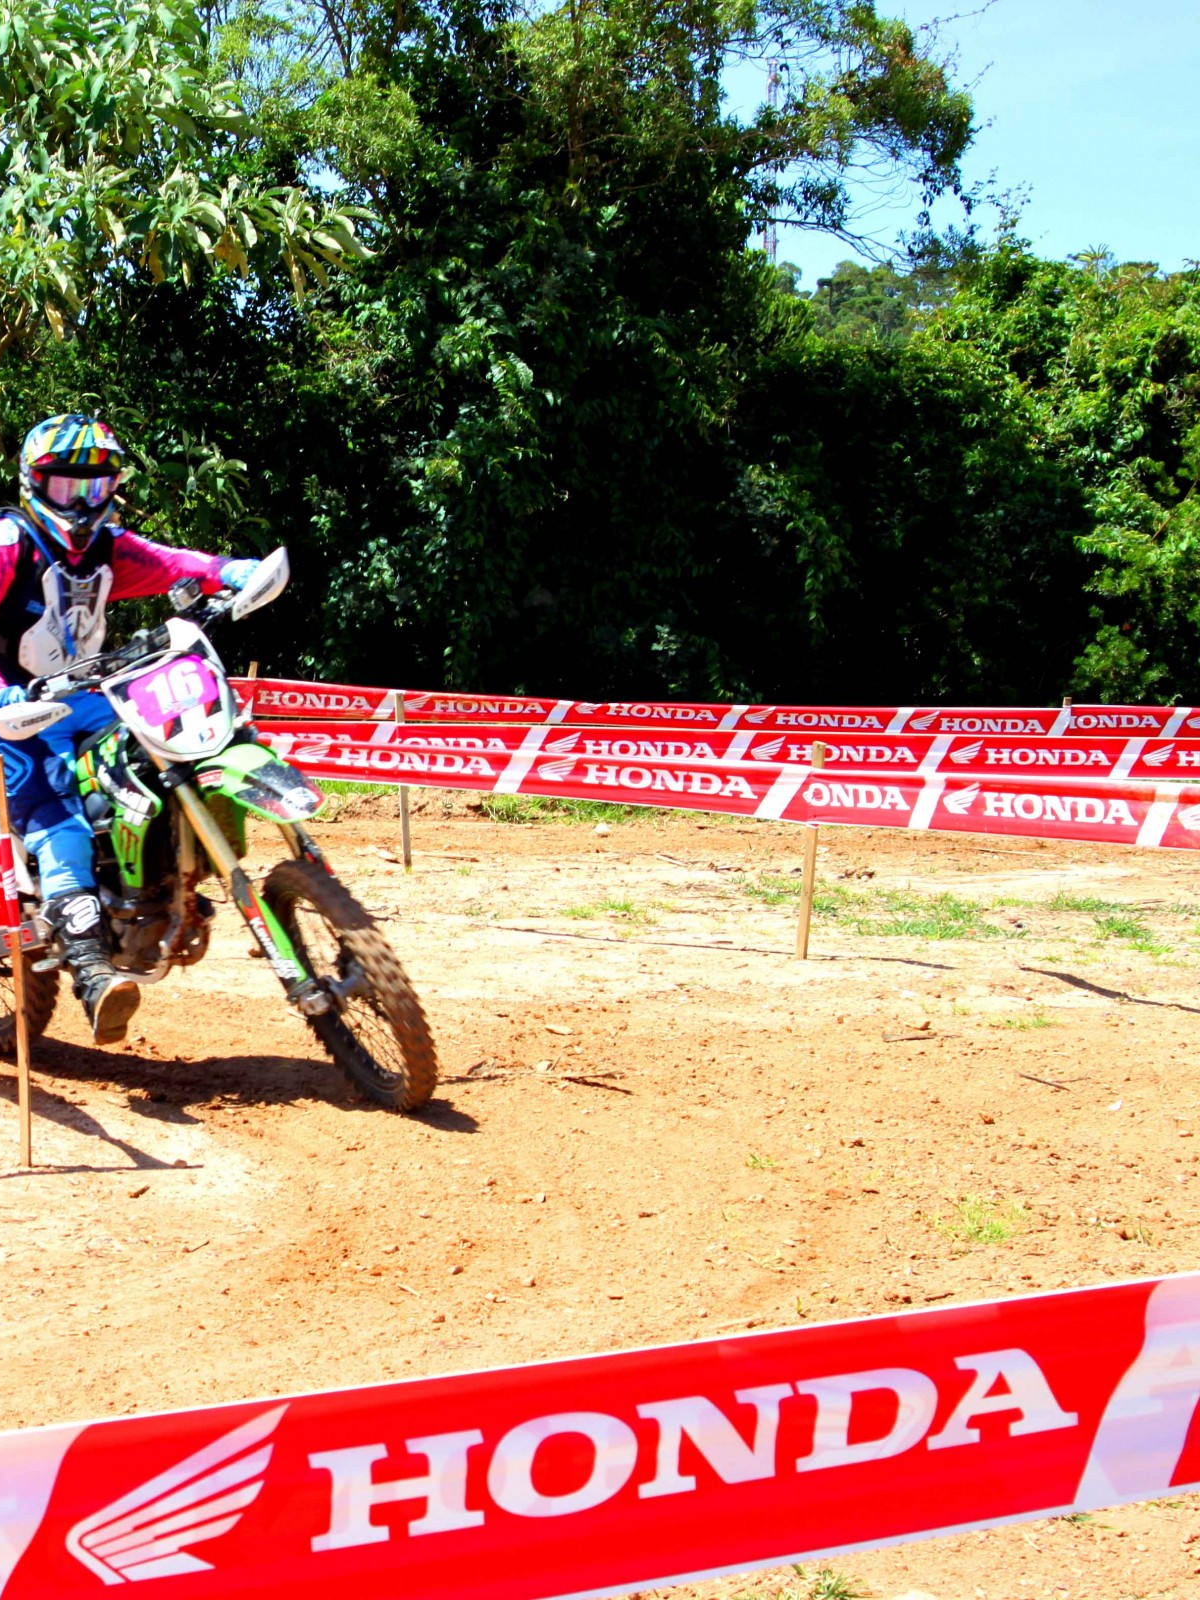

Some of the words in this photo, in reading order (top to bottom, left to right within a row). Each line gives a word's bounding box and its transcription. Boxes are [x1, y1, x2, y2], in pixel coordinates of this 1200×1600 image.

[146, 660, 204, 714] 16
[258, 689, 373, 711] HONDA
[432, 700, 548, 715] HONDA
[21, 712, 54, 727] CIRCUIT
[607, 702, 718, 721] HONDA
[775, 712, 884, 729] HONDA
[939, 717, 1046, 733] HONDA
[582, 739, 718, 759] HONDA
[787, 744, 918, 763] HONDA
[985, 748, 1111, 766] HONDA
[335, 747, 497, 776] HONDA
[582, 763, 758, 799] HONDA
[983, 791, 1138, 826] HONDA
[307, 1348, 1079, 1553] HONDA
